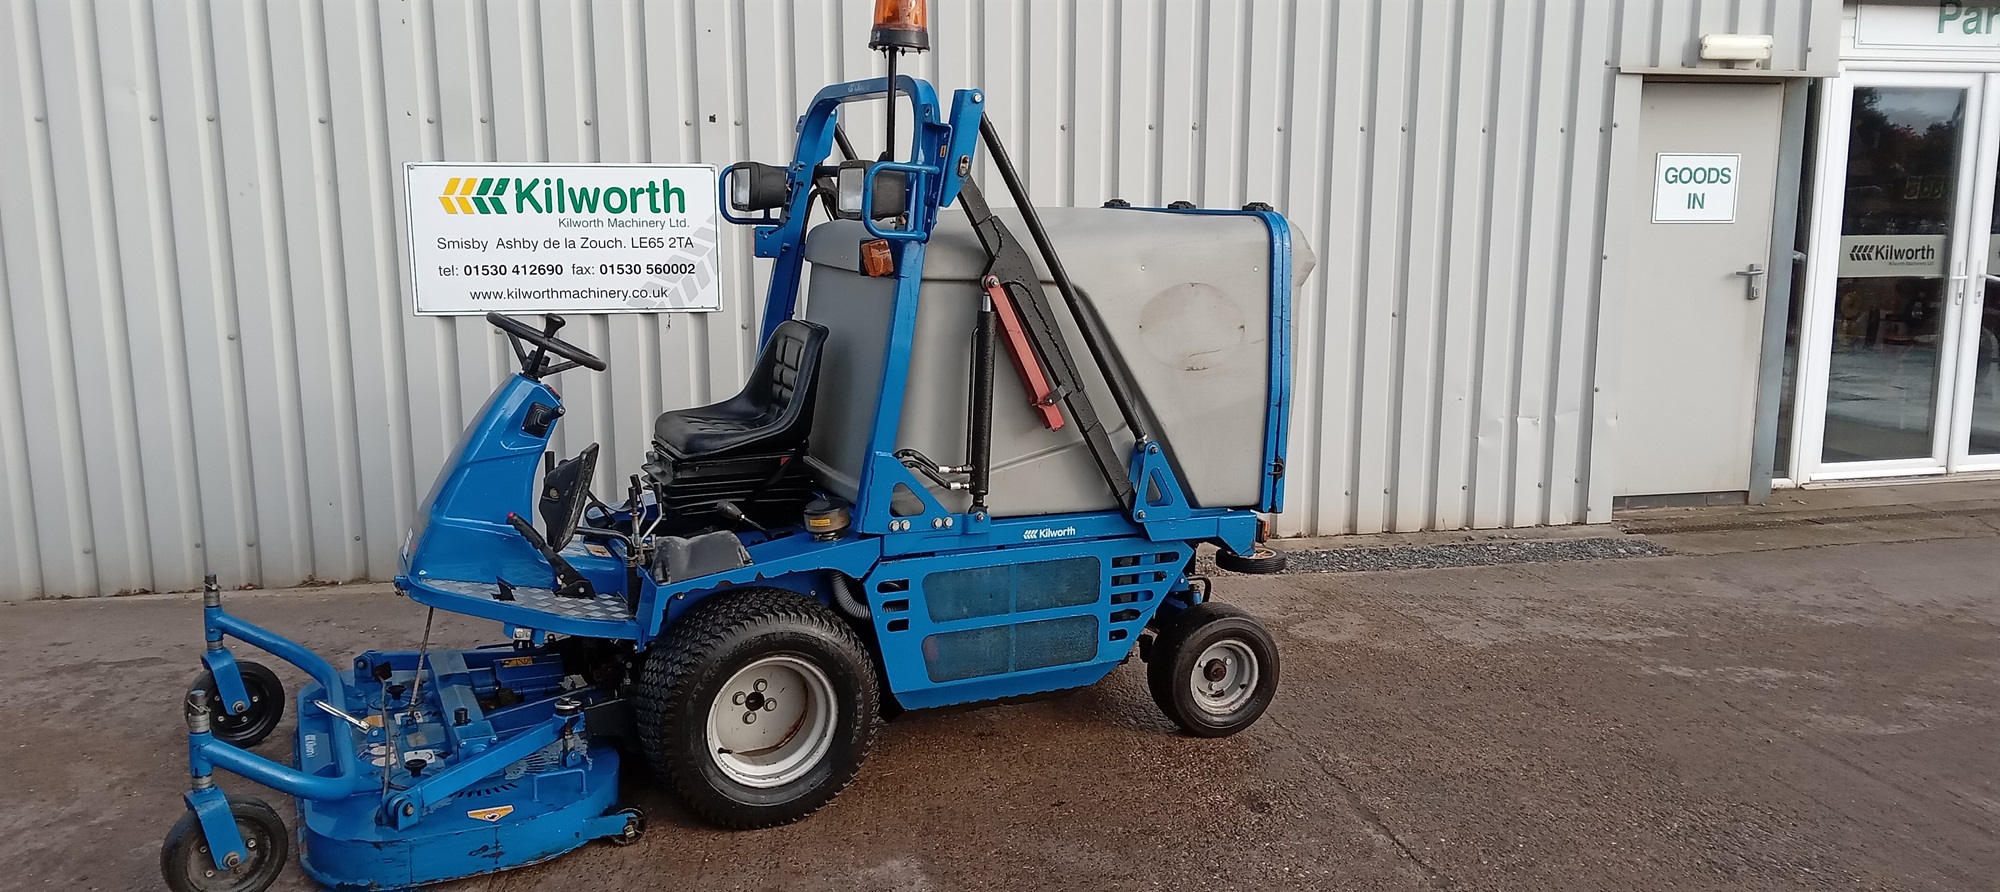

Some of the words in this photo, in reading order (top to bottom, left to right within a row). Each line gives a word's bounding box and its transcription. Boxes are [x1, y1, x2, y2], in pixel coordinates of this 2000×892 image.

[1664, 166, 1732, 185] GOODS
[515, 177, 686, 214] Kilworth
[1687, 192, 1706, 210] IN
[558, 217, 604, 228] Kilworth
[607, 217, 666, 230] Machinery
[669, 218, 690, 228] Ltd.
[437, 237, 489, 253] Smisby
[495, 237, 539, 253] Ashby
[543, 237, 561, 249] de
[564, 237, 576, 249] la
[580, 236, 627, 249] Zouch.
[631, 236, 665, 249] LE65
[668, 236, 694, 249] 2TA
[1875, 244, 1935, 260] Kilworth
[438, 264, 459, 276] tel:
[463, 264, 507, 276] 01530
[511, 264, 564, 276] 412690
[571, 263, 595, 275] fax:
[599, 263, 641, 275] 01530
[646, 263, 696, 275] 560002
[469, 286, 668, 301] www.kilworthmachinery.co.uk
[1039, 526, 1076, 538] Kilworth
